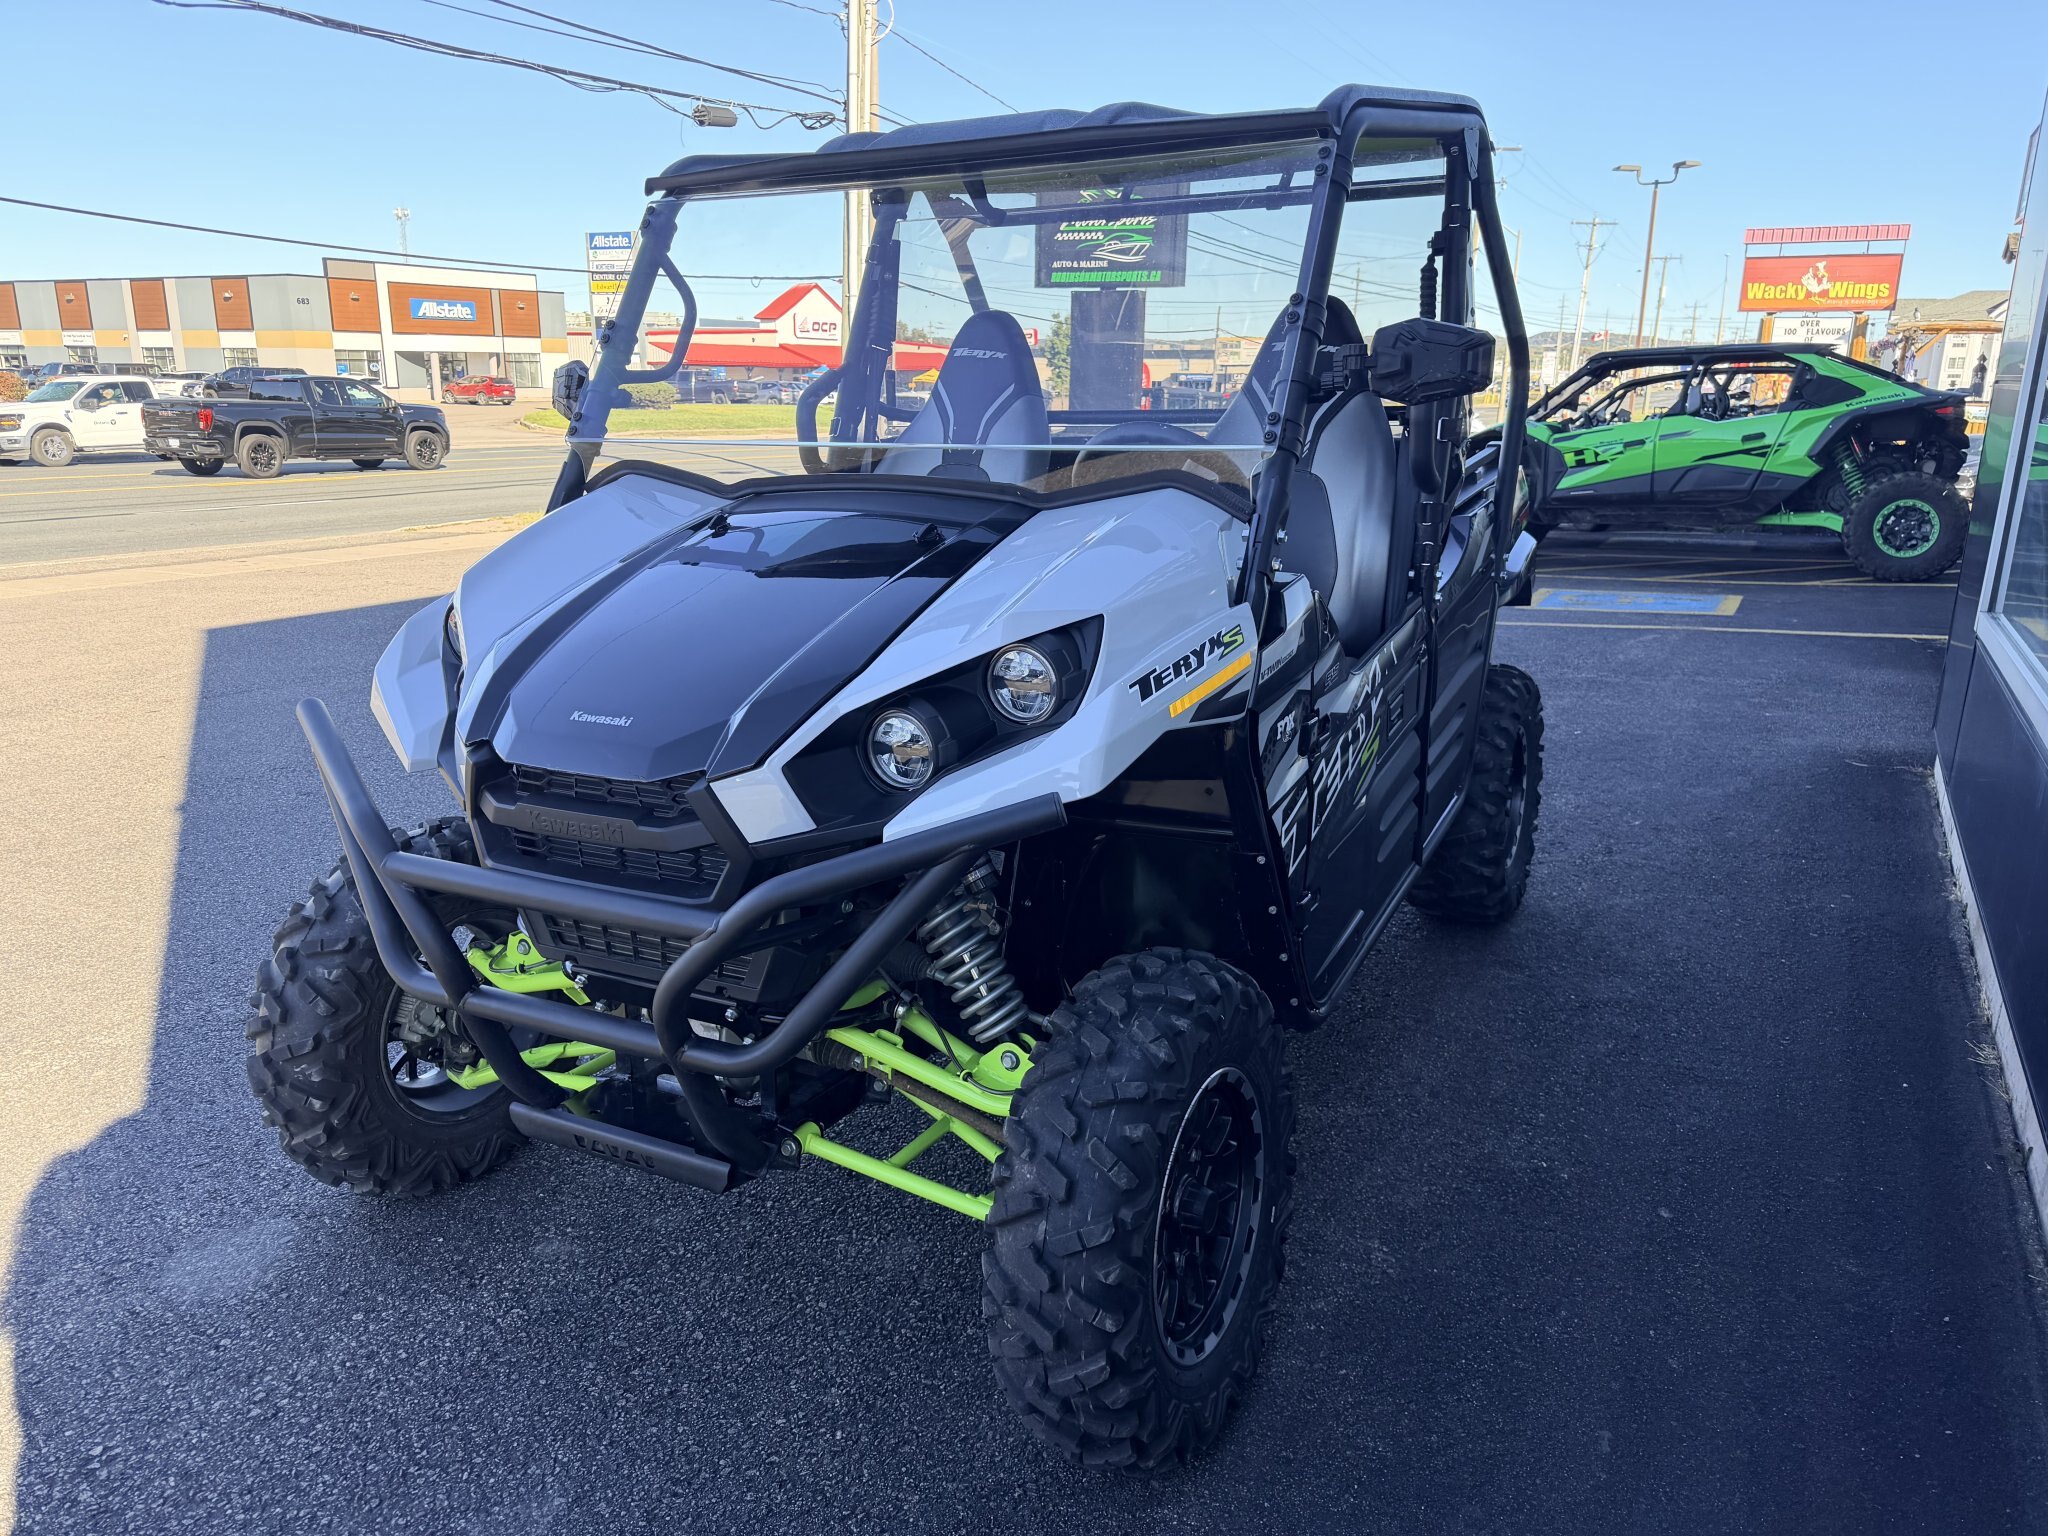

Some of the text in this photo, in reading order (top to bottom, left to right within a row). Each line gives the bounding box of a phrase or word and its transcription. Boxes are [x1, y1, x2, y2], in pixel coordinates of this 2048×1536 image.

[591, 235, 631, 248] Allstate
[1747, 281, 1891, 301] Wacky Wings
[296, 297, 310, 305] 683
[418, 301, 474, 319] Allstate
[1806, 327, 1847, 336] FLAVOURS
[1845, 392, 1907, 408] Kawasaki
[569, 710, 634, 727] Kawasaki
[1276, 710, 1296, 741] FOX
[527, 809, 625, 845] Kawasaki
